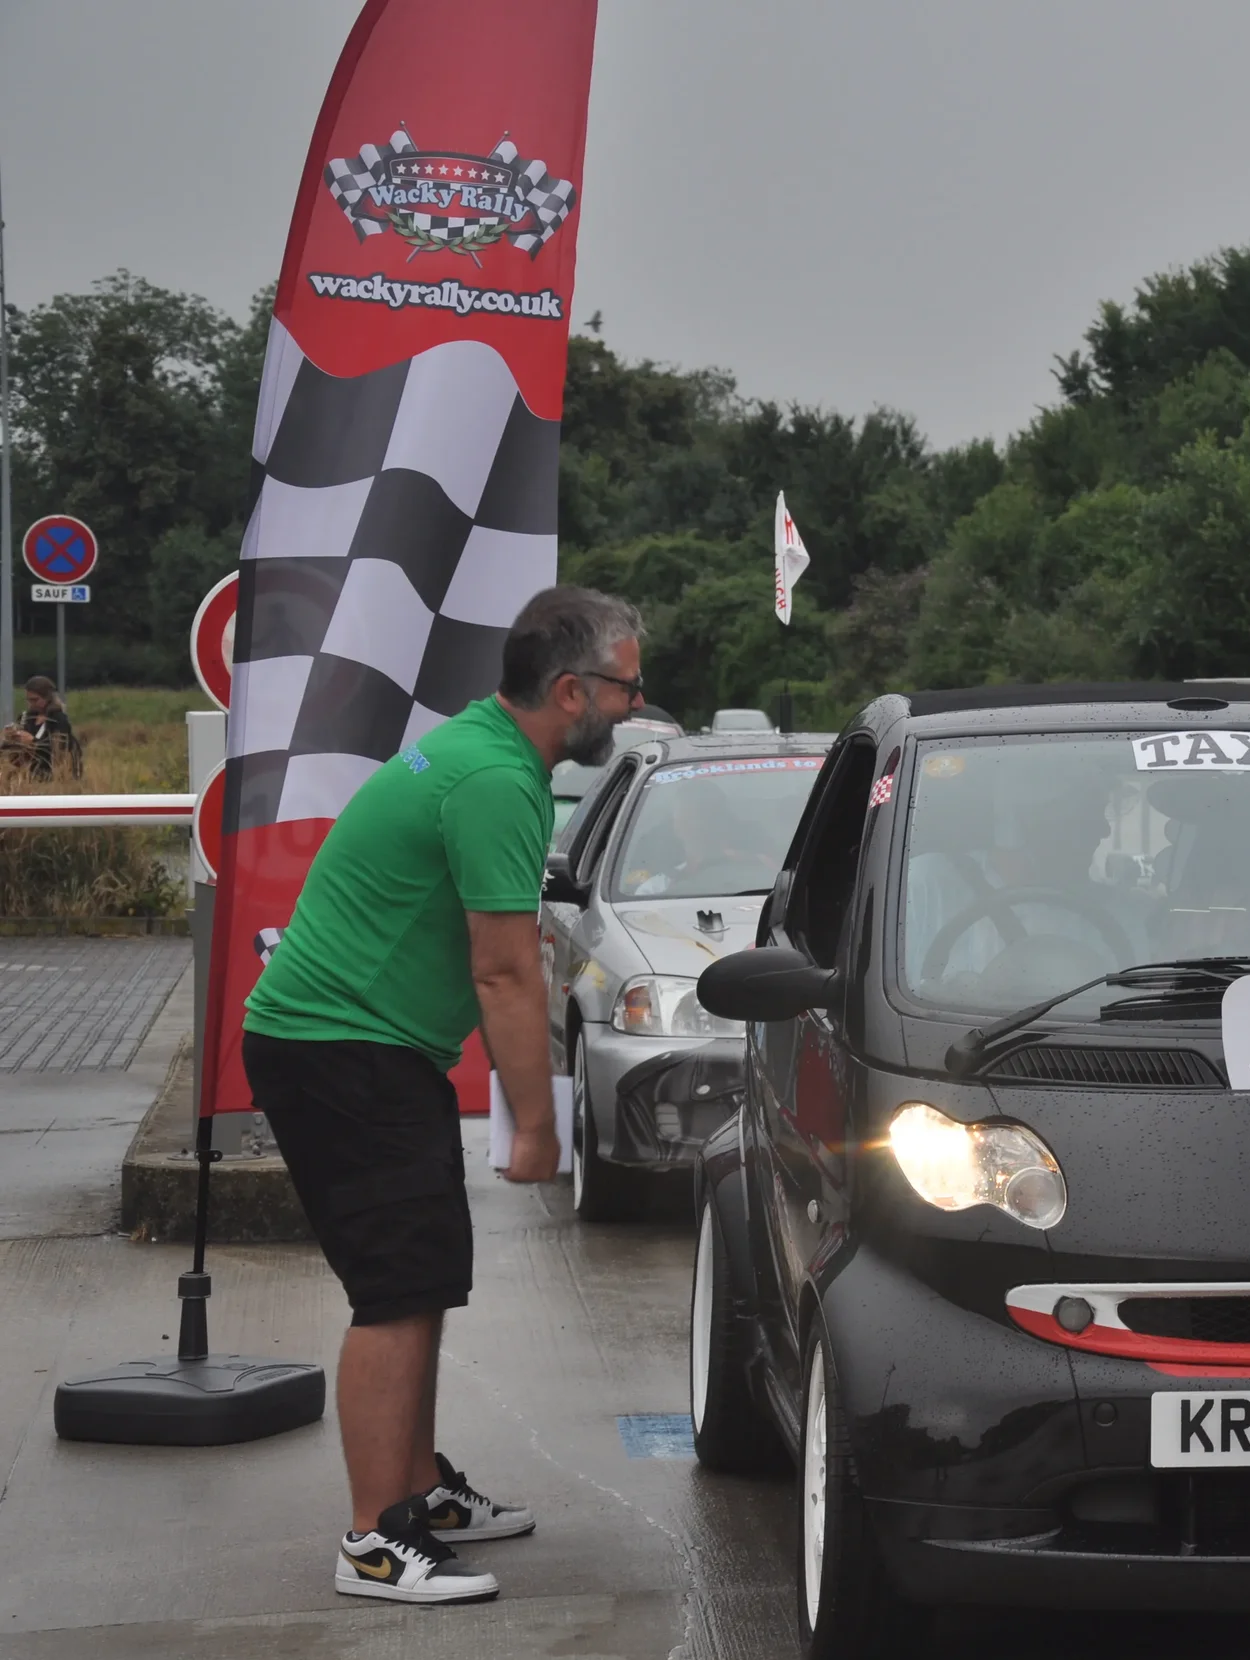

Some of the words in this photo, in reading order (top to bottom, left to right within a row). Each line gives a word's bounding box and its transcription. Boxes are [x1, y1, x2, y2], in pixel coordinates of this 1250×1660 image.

[367, 182, 456, 209] Wacky
[462, 186, 530, 223] Rally
[308, 273, 563, 319] wackyrally.co.uk
[35, 588, 68, 599] SAUF
